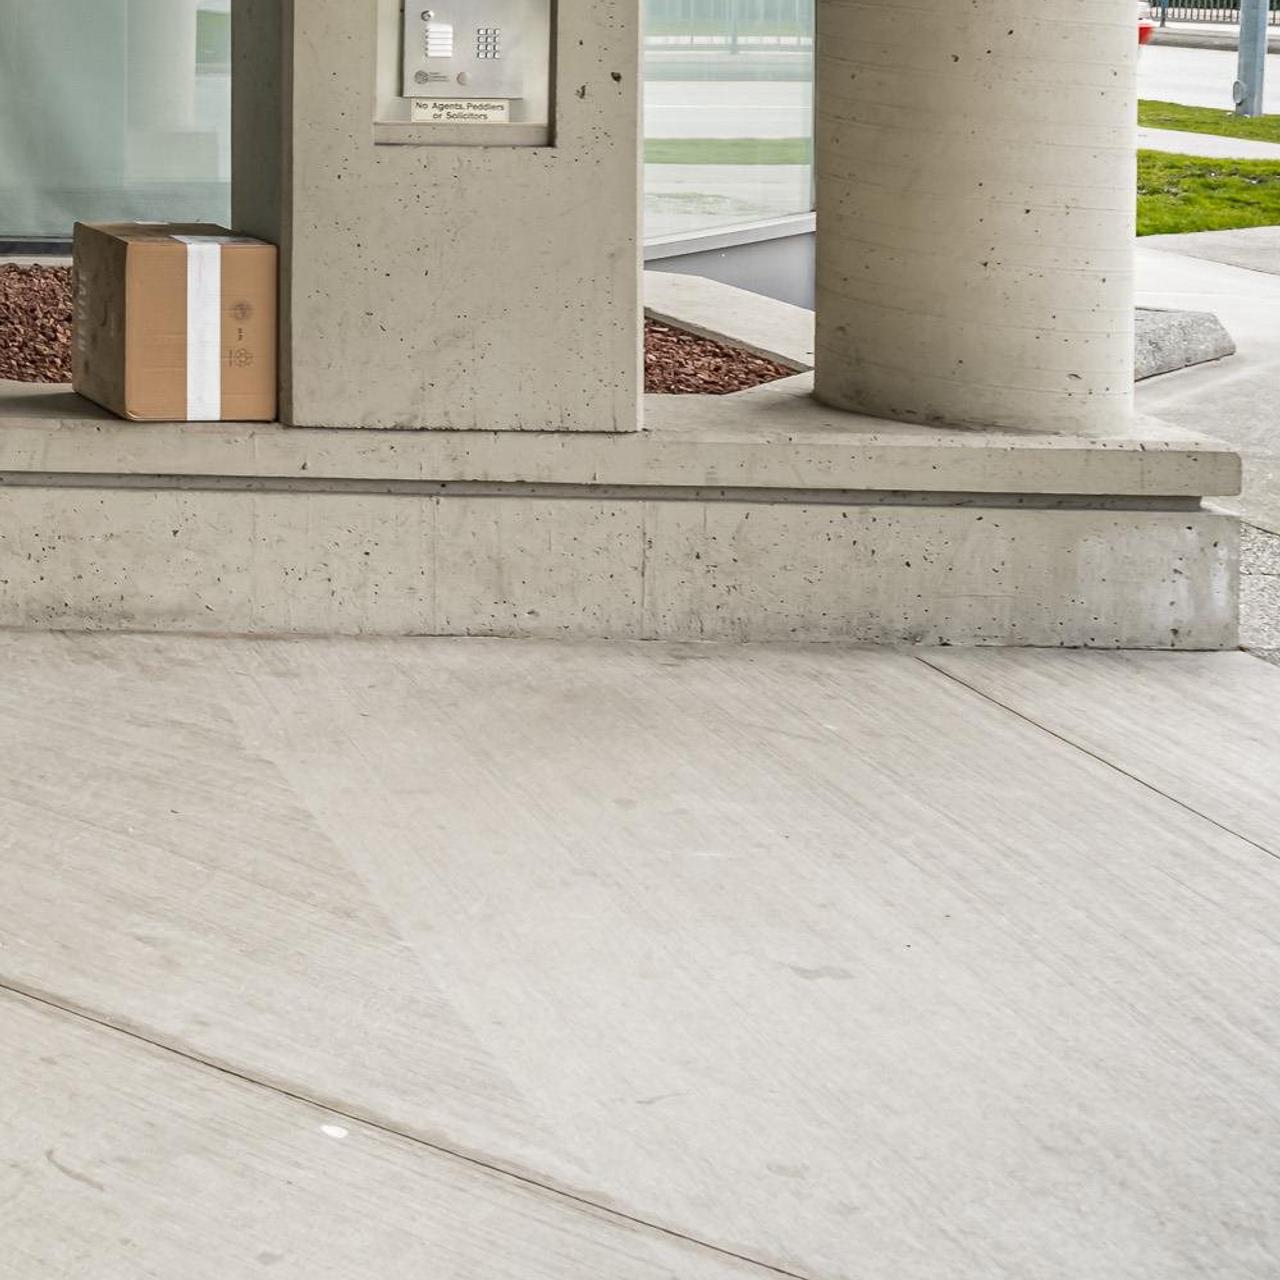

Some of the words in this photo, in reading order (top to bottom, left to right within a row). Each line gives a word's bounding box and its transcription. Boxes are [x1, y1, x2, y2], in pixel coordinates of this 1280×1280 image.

[415, 101, 429, 110] No
[466, 102, 505, 111] Peddlers
[432, 112, 443, 120] or
[446, 111, 489, 120] Solicitors
